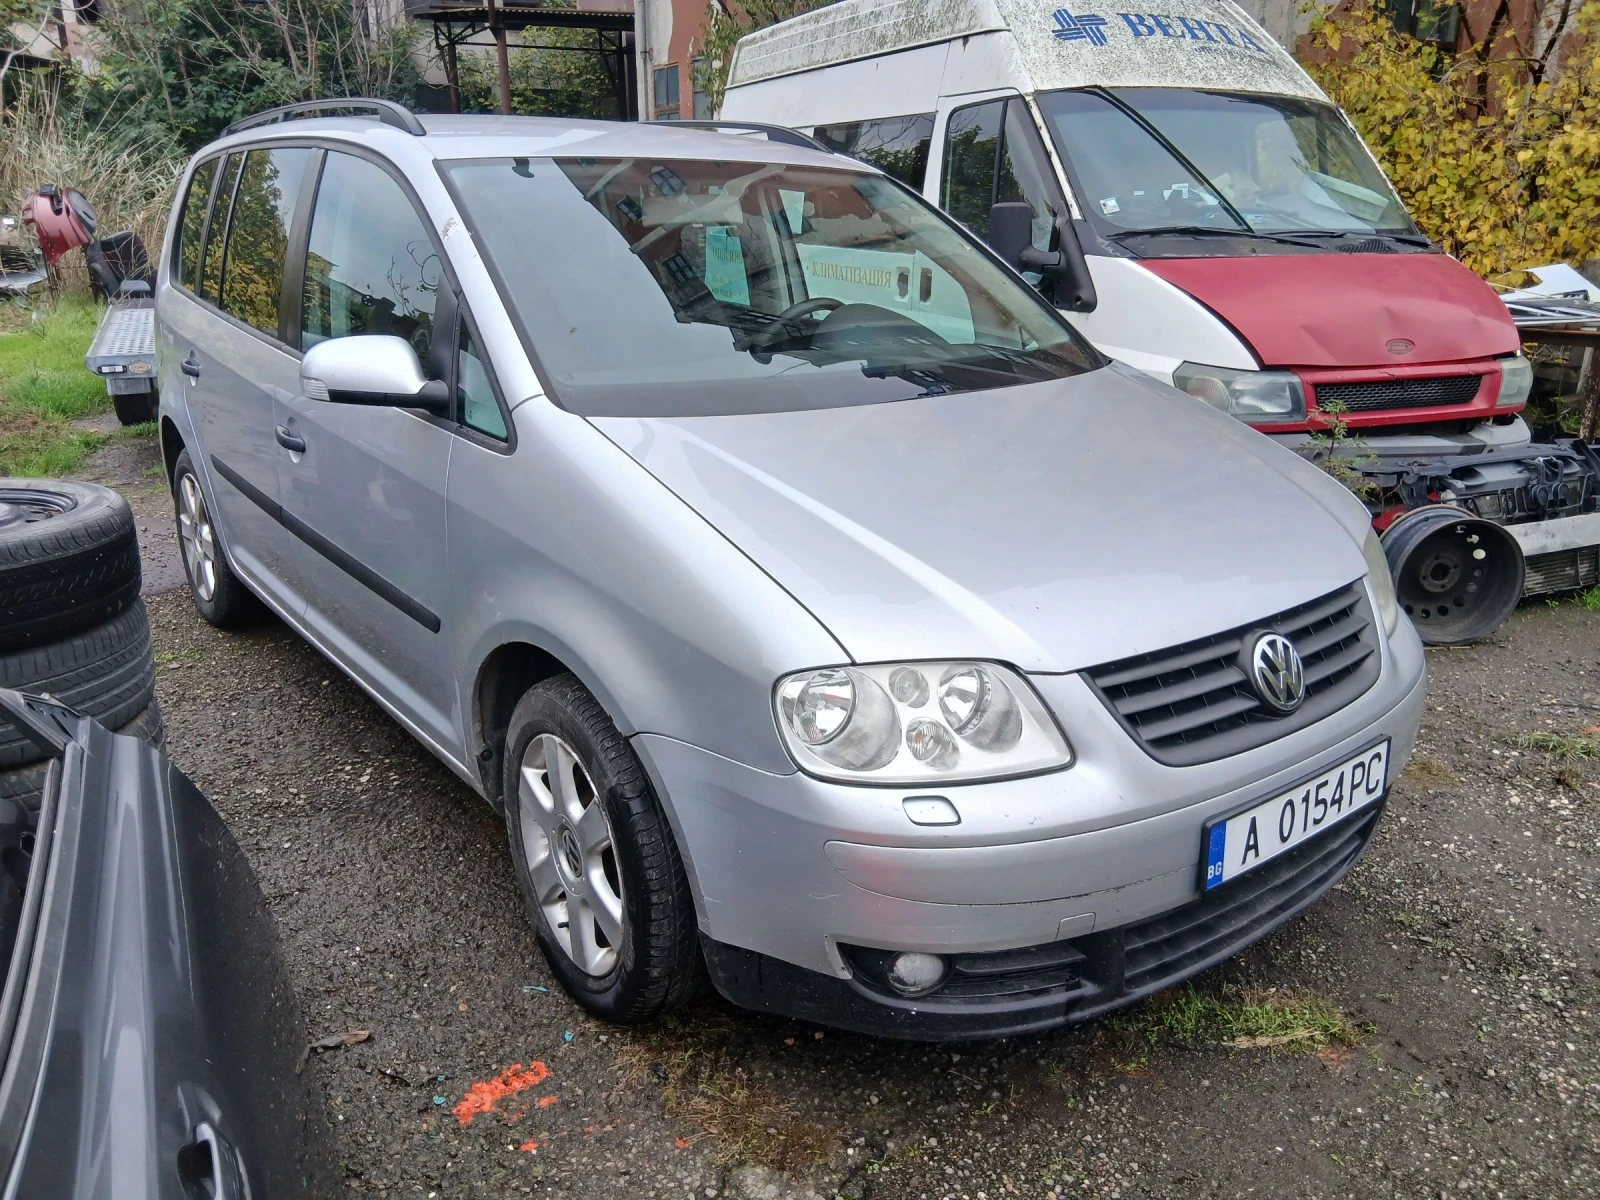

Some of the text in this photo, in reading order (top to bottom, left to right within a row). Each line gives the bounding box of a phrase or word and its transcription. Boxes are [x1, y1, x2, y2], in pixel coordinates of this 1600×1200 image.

[1117, 13, 1266, 53] ВЕНТА
[812, 262, 892, 288] КЛИМАТИЗАЦИЯ
[1241, 815, 1260, 866] A
[1207, 861, 1223, 880] BG
